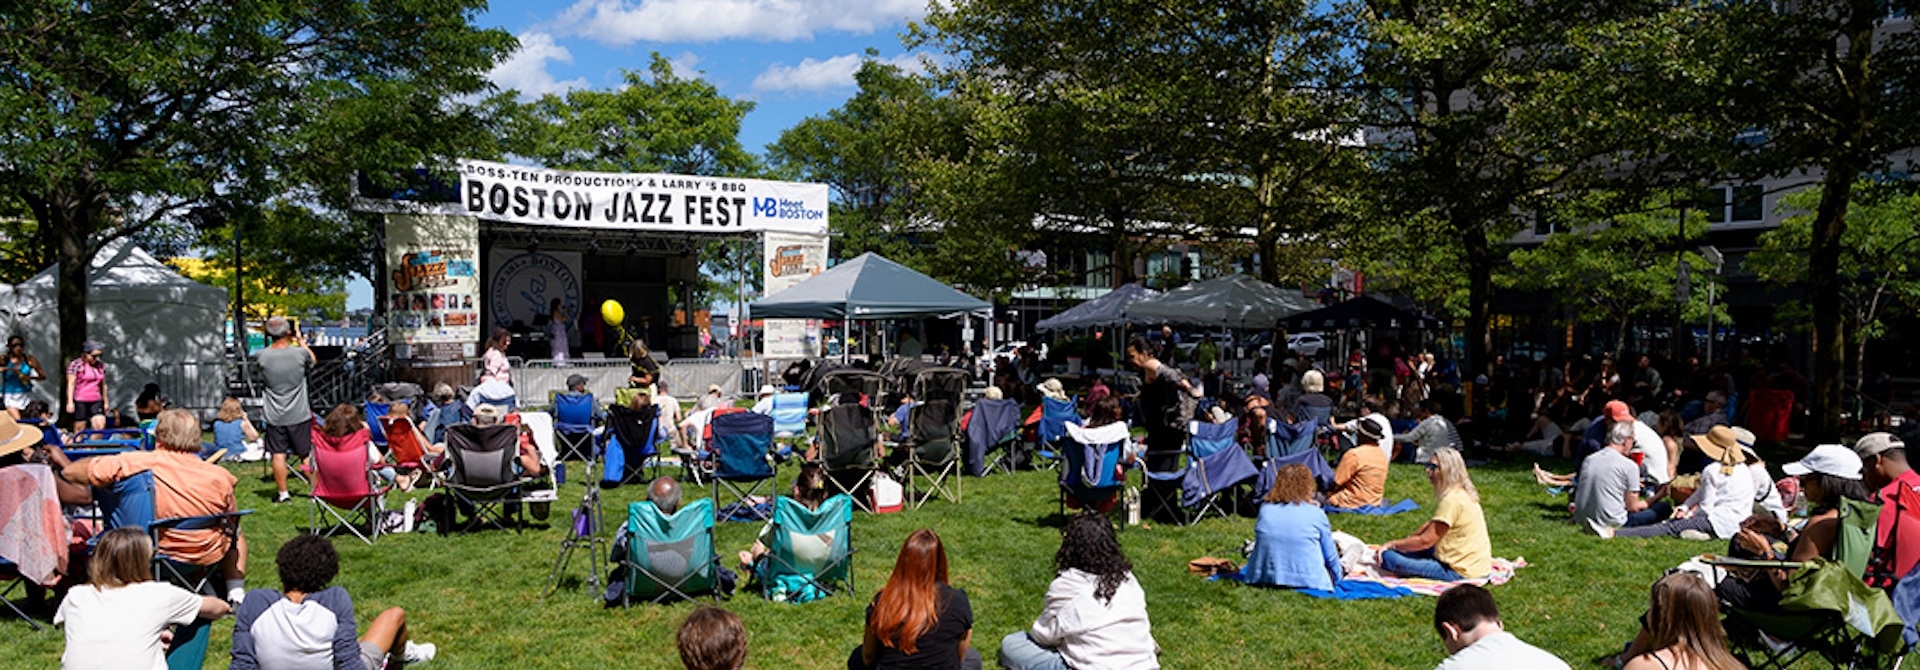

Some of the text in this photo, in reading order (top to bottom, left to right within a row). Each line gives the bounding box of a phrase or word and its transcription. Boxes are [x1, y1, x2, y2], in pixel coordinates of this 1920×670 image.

[467, 164, 539, 183] BOSS-TEN
[648, 178, 656, 187] &
[662, 179, 701, 189] LARRY
[722, 182, 746, 192] BBQ
[467, 180, 746, 226] BOSTON JAZZ FEST
[753, 196, 777, 217] MB
[779, 198, 804, 208] Meet
[779, 208, 824, 220] BOSTON
[531, 255, 575, 291] BOSTON
